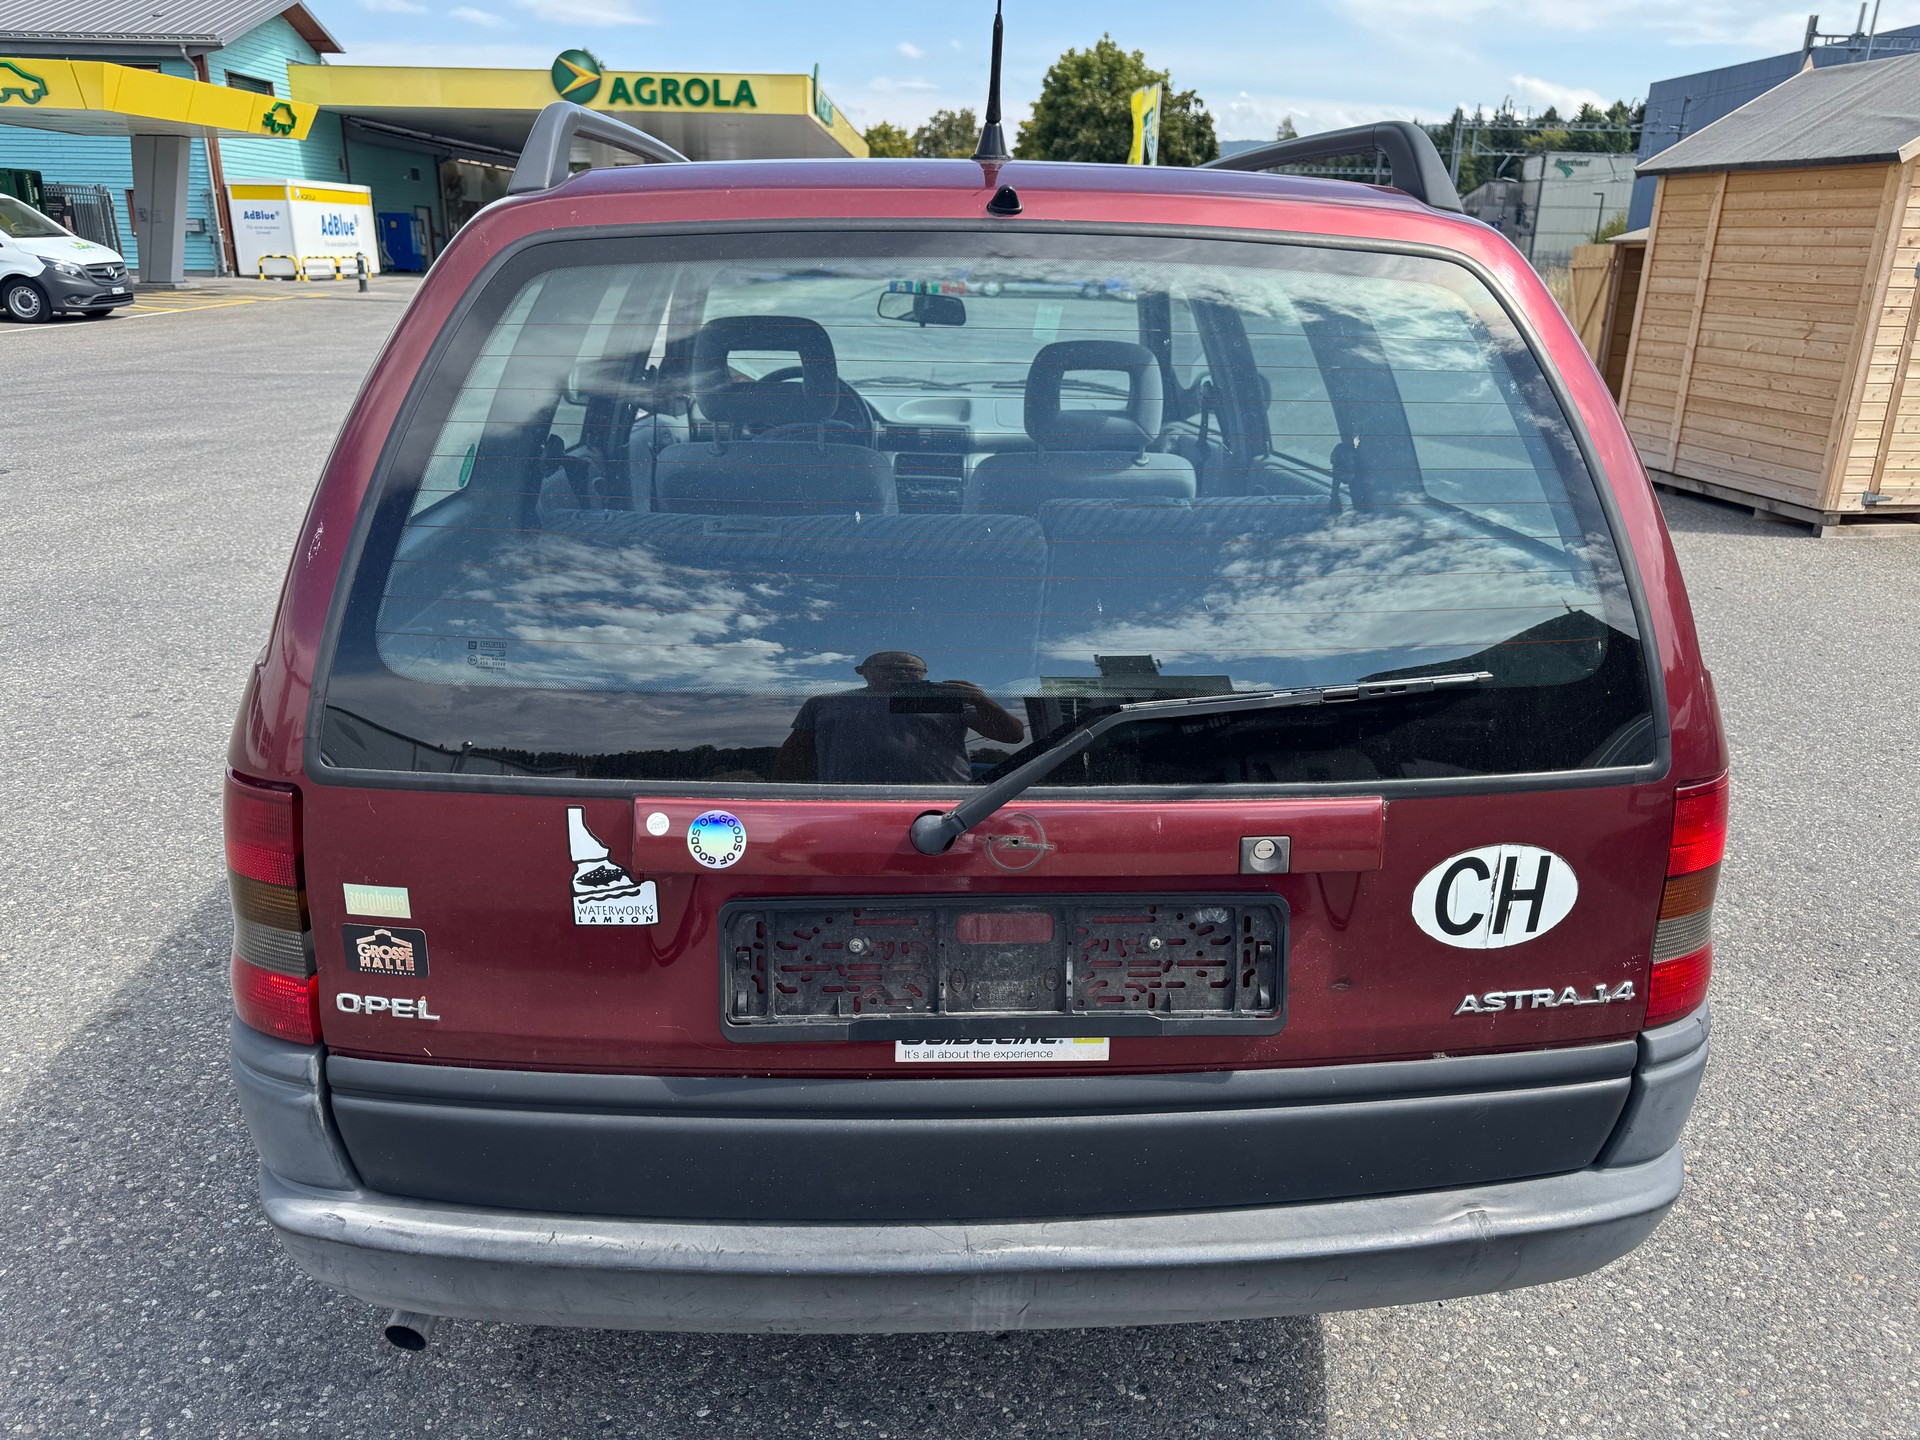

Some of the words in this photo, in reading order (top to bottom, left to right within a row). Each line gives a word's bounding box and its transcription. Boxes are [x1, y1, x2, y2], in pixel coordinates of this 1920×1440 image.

[608, 77, 757, 107] AGROLA
[700, 814, 715, 827] OF
[719, 815, 743, 852] GOODS
[691, 828, 717, 865] GOODS
[720, 852, 735, 865] OF
[1435, 855, 1551, 936] CH
[577, 904, 654, 915] WATERWORKS
[578, 915, 654, 923] LAMSON
[357, 943, 414, 960] GROSSE
[360, 956, 415, 971] HALLE
[336, 992, 440, 1021] OPEL
[1453, 986, 1582, 1016] ASTRA
[922, 1049, 935, 1059] all
[938, 1049, 970, 1059] about
[973, 1049, 991, 1059] the
[993, 1049, 1054, 1061] experience
